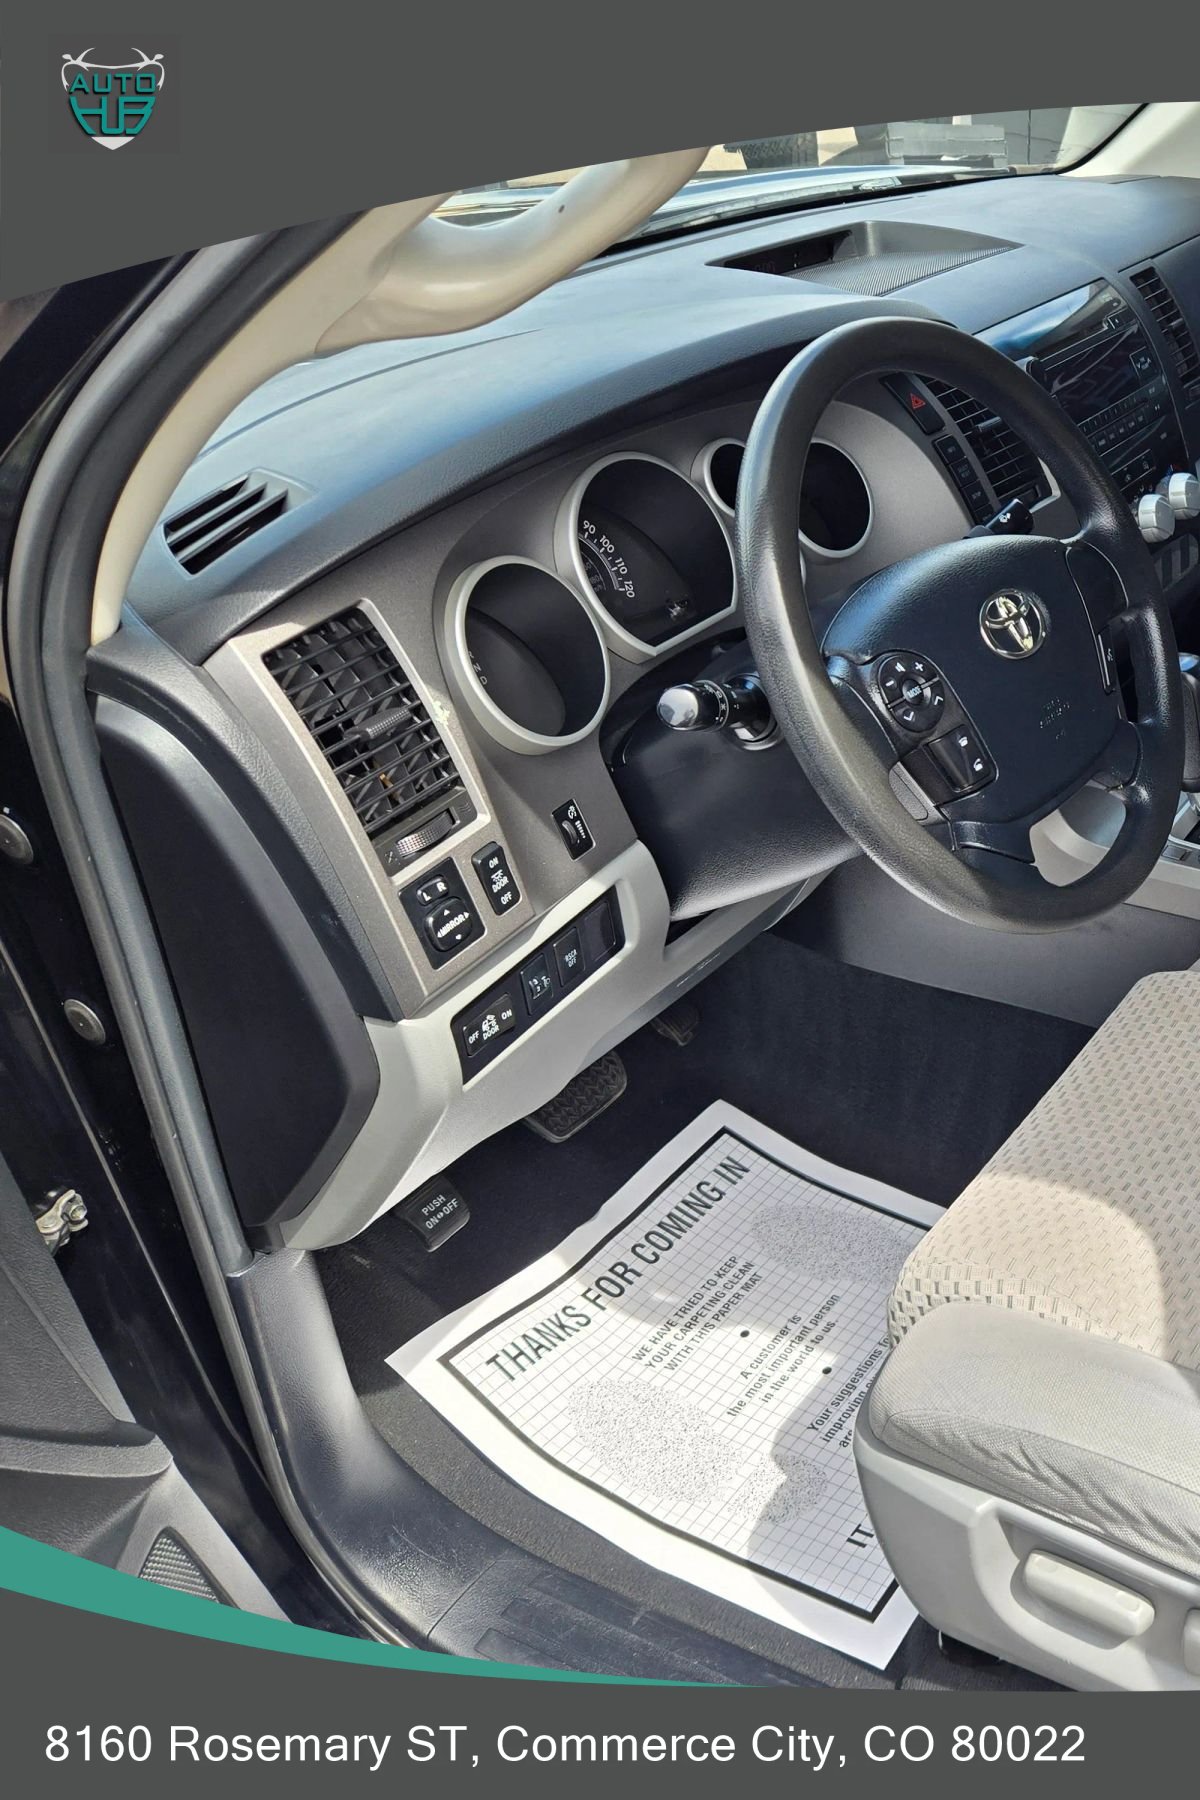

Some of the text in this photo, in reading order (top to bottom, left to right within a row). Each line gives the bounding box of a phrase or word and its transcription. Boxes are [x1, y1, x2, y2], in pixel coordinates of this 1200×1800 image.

[583, 520, 596, 534] 90
[600, 535, 615, 553] 100
[615, 557, 628, 575] 110
[624, 580, 635, 598] 120
[488, 856, 499, 869] ON
[422, 882, 447, 902] L R
[491, 876, 510, 893] DOOR
[500, 891, 513, 905] OFF
[440, 913, 466, 937] MIRROR
[567, 957, 577, 968] OFF
[501, 1008, 513, 1020] ON
[468, 1030, 480, 1044] OFF
[482, 1024, 500, 1041] DOOR
[421, 1194, 447, 1216] PUSH
[485, 1155, 751, 1381] THANKS FOR COMING IN
[631, 1255, 739, 1361] WE HAVE TRIED TO KEEP
[644, 1261, 755, 1369] YOUR CARPETING CLEAN
[663, 1271, 763, 1371] WITH THIS PAPER MAT
[726, 1294, 841, 1417] the most important person
[740, 1313, 802, 1380] A customer is
[759, 1320, 839, 1404] in the world to us.
[806, 1408, 833, 1431] Your
[831, 1348, 883, 1408] suggestions
[846, 1523, 875, 1549] IT
